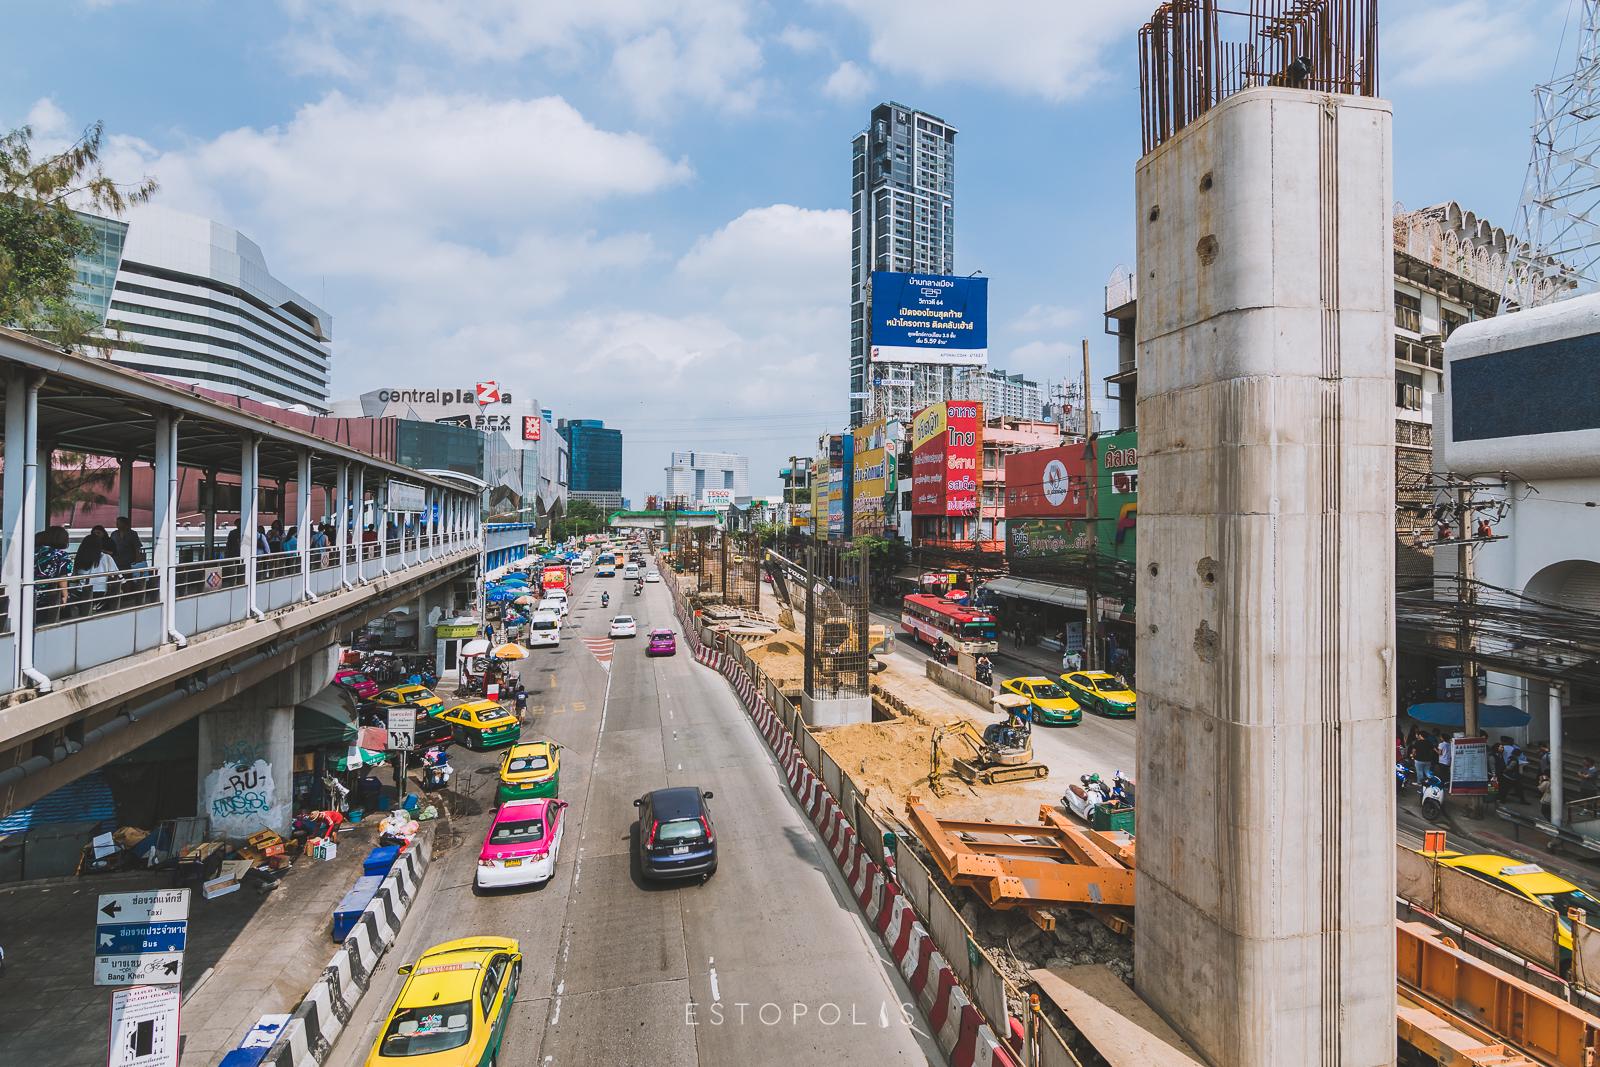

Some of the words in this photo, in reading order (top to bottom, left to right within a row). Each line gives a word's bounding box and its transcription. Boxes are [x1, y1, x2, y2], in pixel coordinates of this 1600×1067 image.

[909, 277, 954, 288] บ้านกลางเมือง
[899, 308, 963, 320] เปิดจองโซนสุดท้าย
[886, 318, 930, 328] หน้าโครงการ
[948, 406, 977, 418] อาหาร
[475, 415, 511, 426] SFX
[948, 426, 976, 447] ไทย
[947, 454, 976, 470] อีสาน
[1105, 444, 1137, 468] คัลเล
[947, 475, 977, 491] รสเด็ด
[787, 567, 808, 583] VOLV
[132, 890, 183, 905] ช่องรถแท็กซี่
[146, 908, 163, 916] Taxi
[120, 924, 186, 937] ช่องรถประจำทาง
[142, 940, 158, 948] Bus
[111, 959, 142, 968] บางเขน
[107, 973, 125, 981] Bang
[127, 972, 145, 980] Khen
